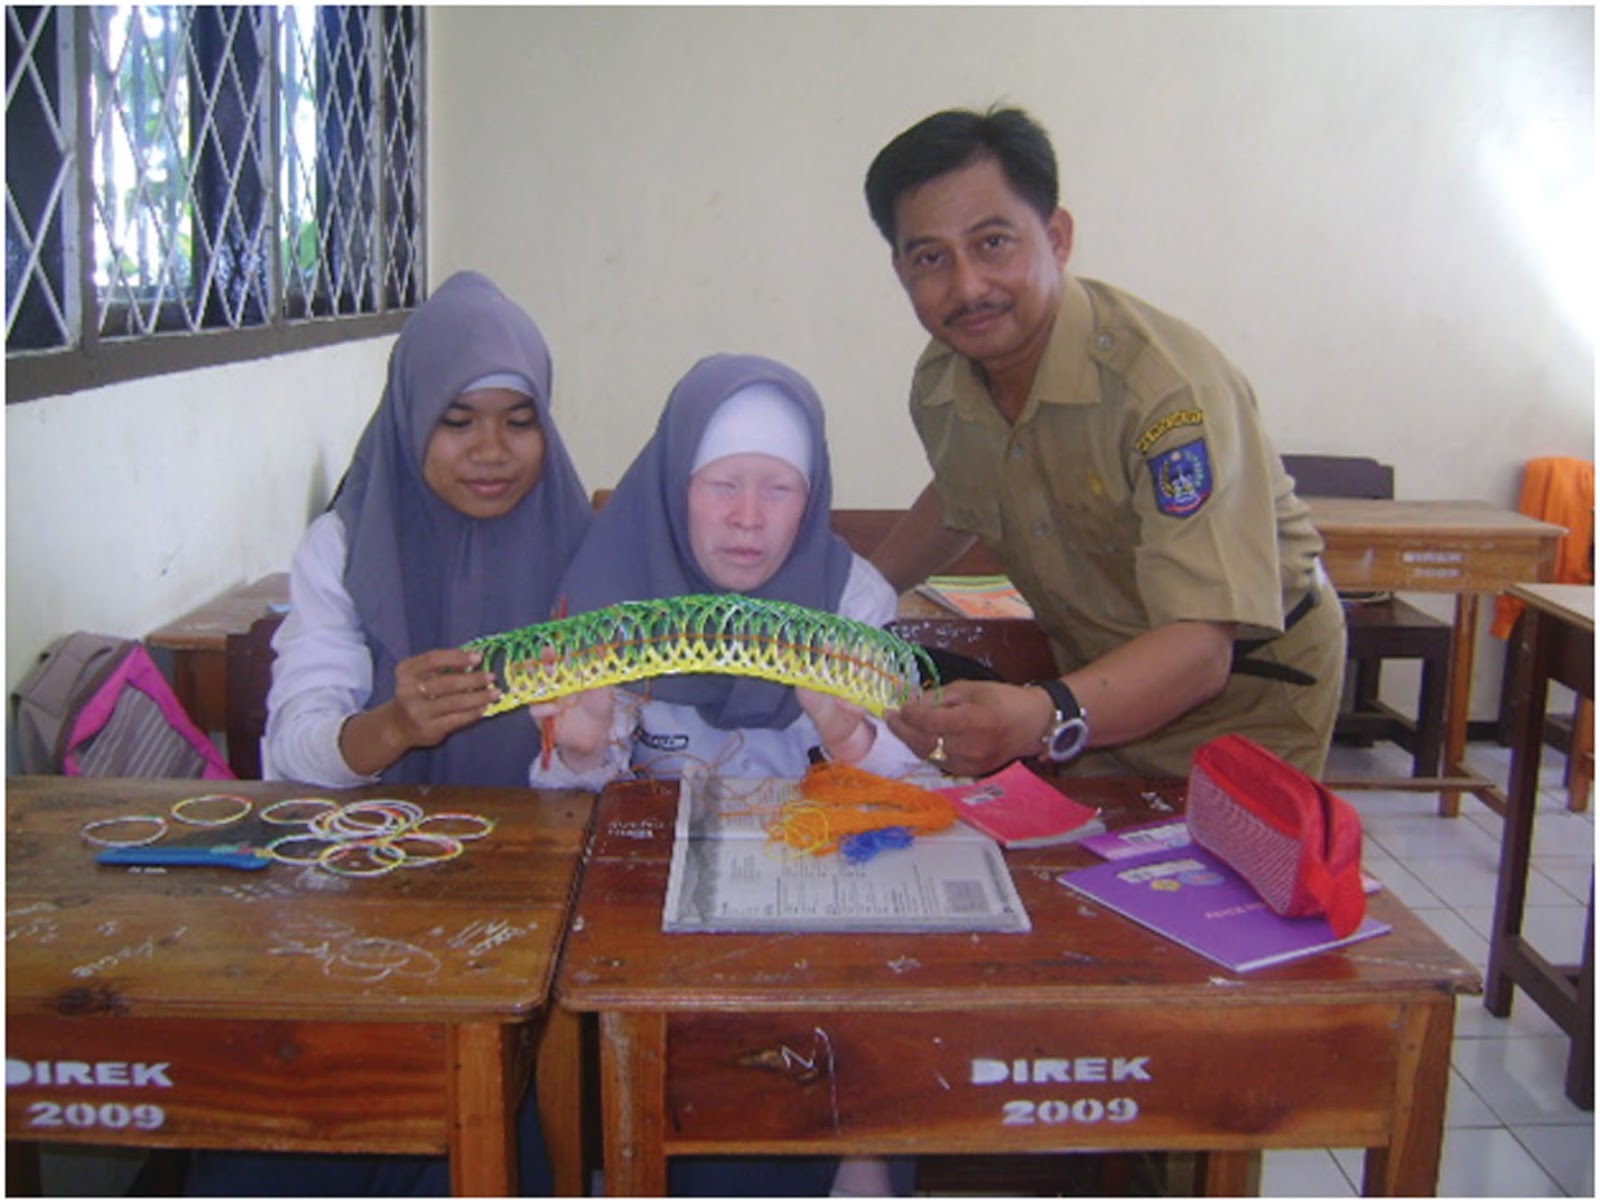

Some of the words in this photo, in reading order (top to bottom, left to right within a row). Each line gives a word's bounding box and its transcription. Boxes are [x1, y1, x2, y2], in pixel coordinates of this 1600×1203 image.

[6, 1058, 174, 1087] DIREK
[970, 1056, 1151, 1084] DIREK
[29, 1101, 165, 1130] 2009
[1002, 1098, 1139, 1126] 2009
